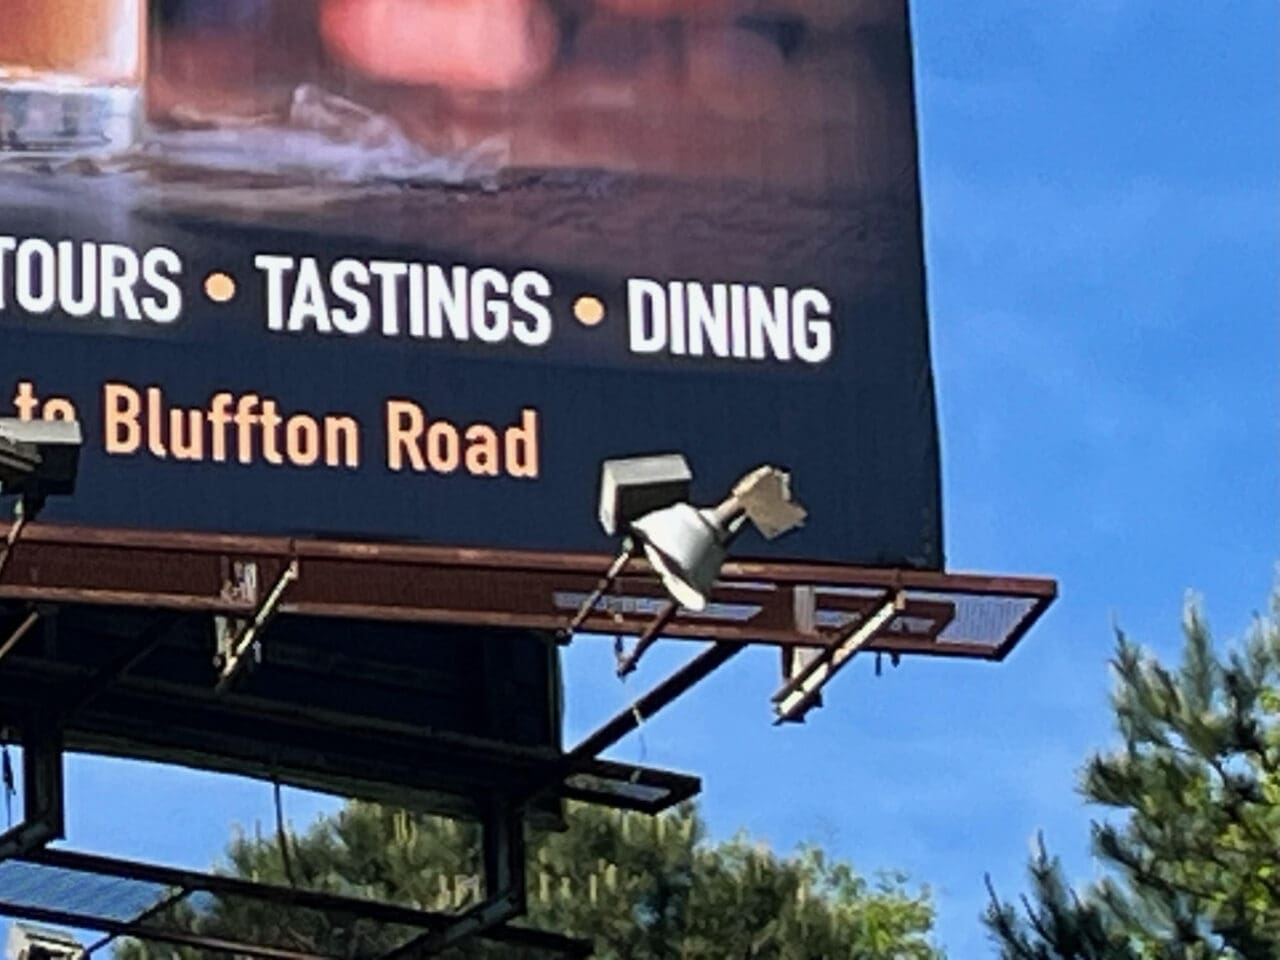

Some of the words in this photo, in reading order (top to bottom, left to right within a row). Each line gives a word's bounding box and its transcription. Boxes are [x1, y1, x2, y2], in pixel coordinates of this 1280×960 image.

[254, 254, 553, 346] TASTINGS
[627, 278, 832, 364] DINING
[104, 383, 359, 469] Bluffton
[386, 400, 539, 483] Road
